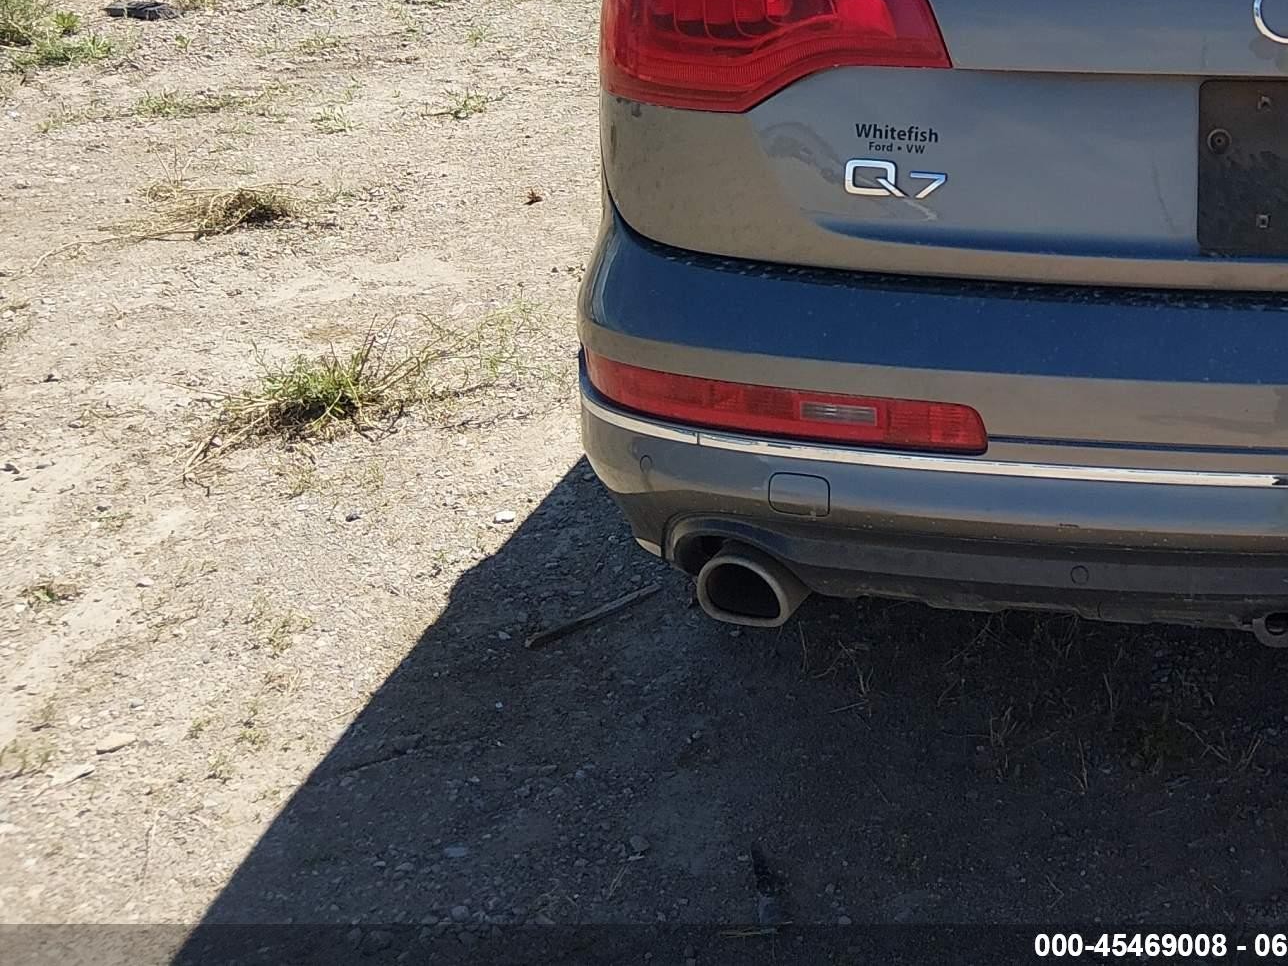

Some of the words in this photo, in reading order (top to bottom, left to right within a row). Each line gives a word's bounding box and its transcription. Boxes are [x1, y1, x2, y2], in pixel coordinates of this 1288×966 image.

[855, 123, 939, 143] Whitefish
[868, 141, 893, 153] Ford
[906, 144, 926, 155] VW
[845, 159, 949, 199] Q7
